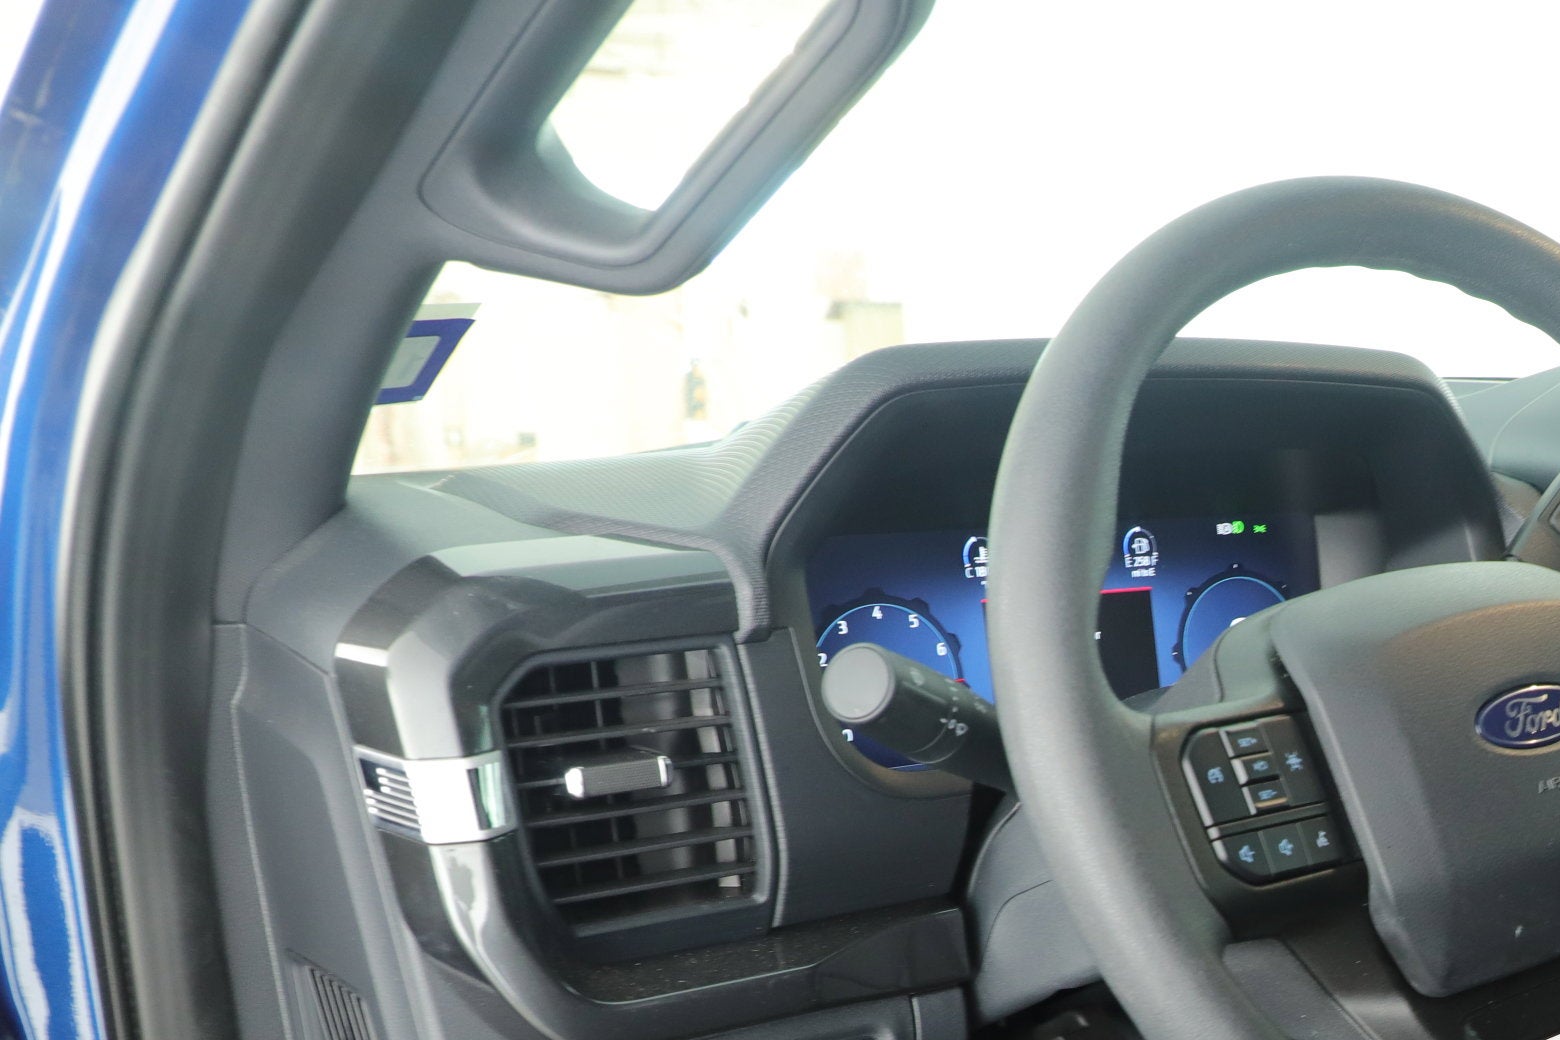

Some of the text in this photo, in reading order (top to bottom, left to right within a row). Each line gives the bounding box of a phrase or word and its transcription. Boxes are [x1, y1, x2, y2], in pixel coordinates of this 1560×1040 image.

[872, 606, 883, 620] 4
[837, 620, 848, 635] 3
[908, 614, 920, 628] 5
[936, 642, 948, 656] 6
[817, 652, 829, 667] 2
